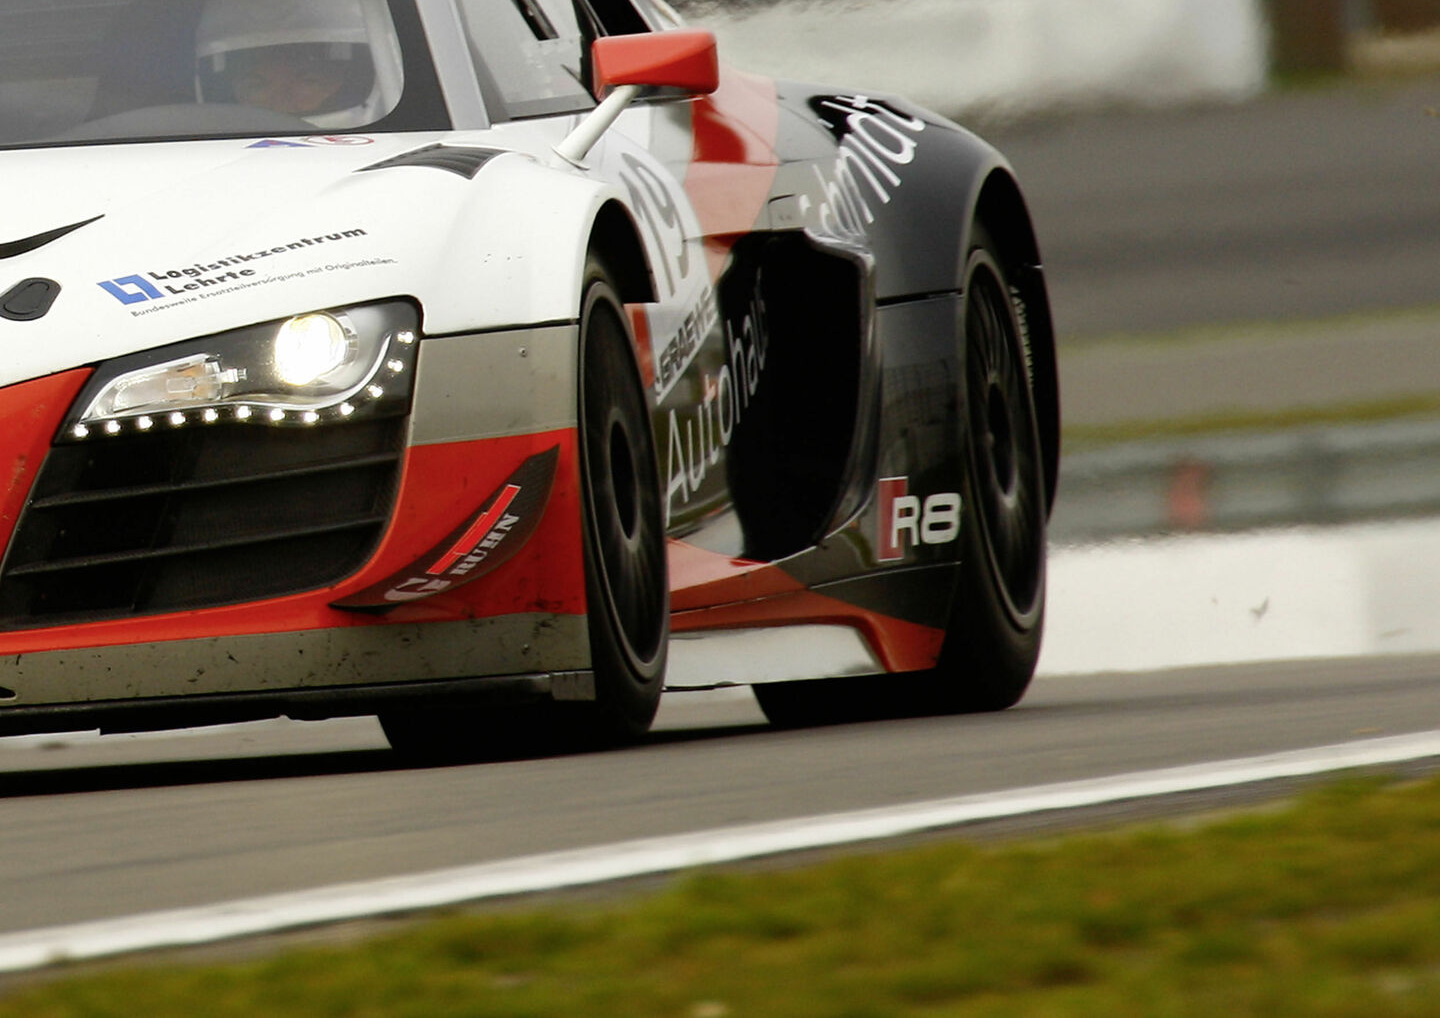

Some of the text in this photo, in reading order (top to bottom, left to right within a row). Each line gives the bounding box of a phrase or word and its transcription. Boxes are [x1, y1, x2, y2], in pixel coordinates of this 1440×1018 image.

[147, 227, 368, 279] Logistikzentrum
[164, 268, 257, 296] Lehrte
[891, 492, 962, 549] R8
